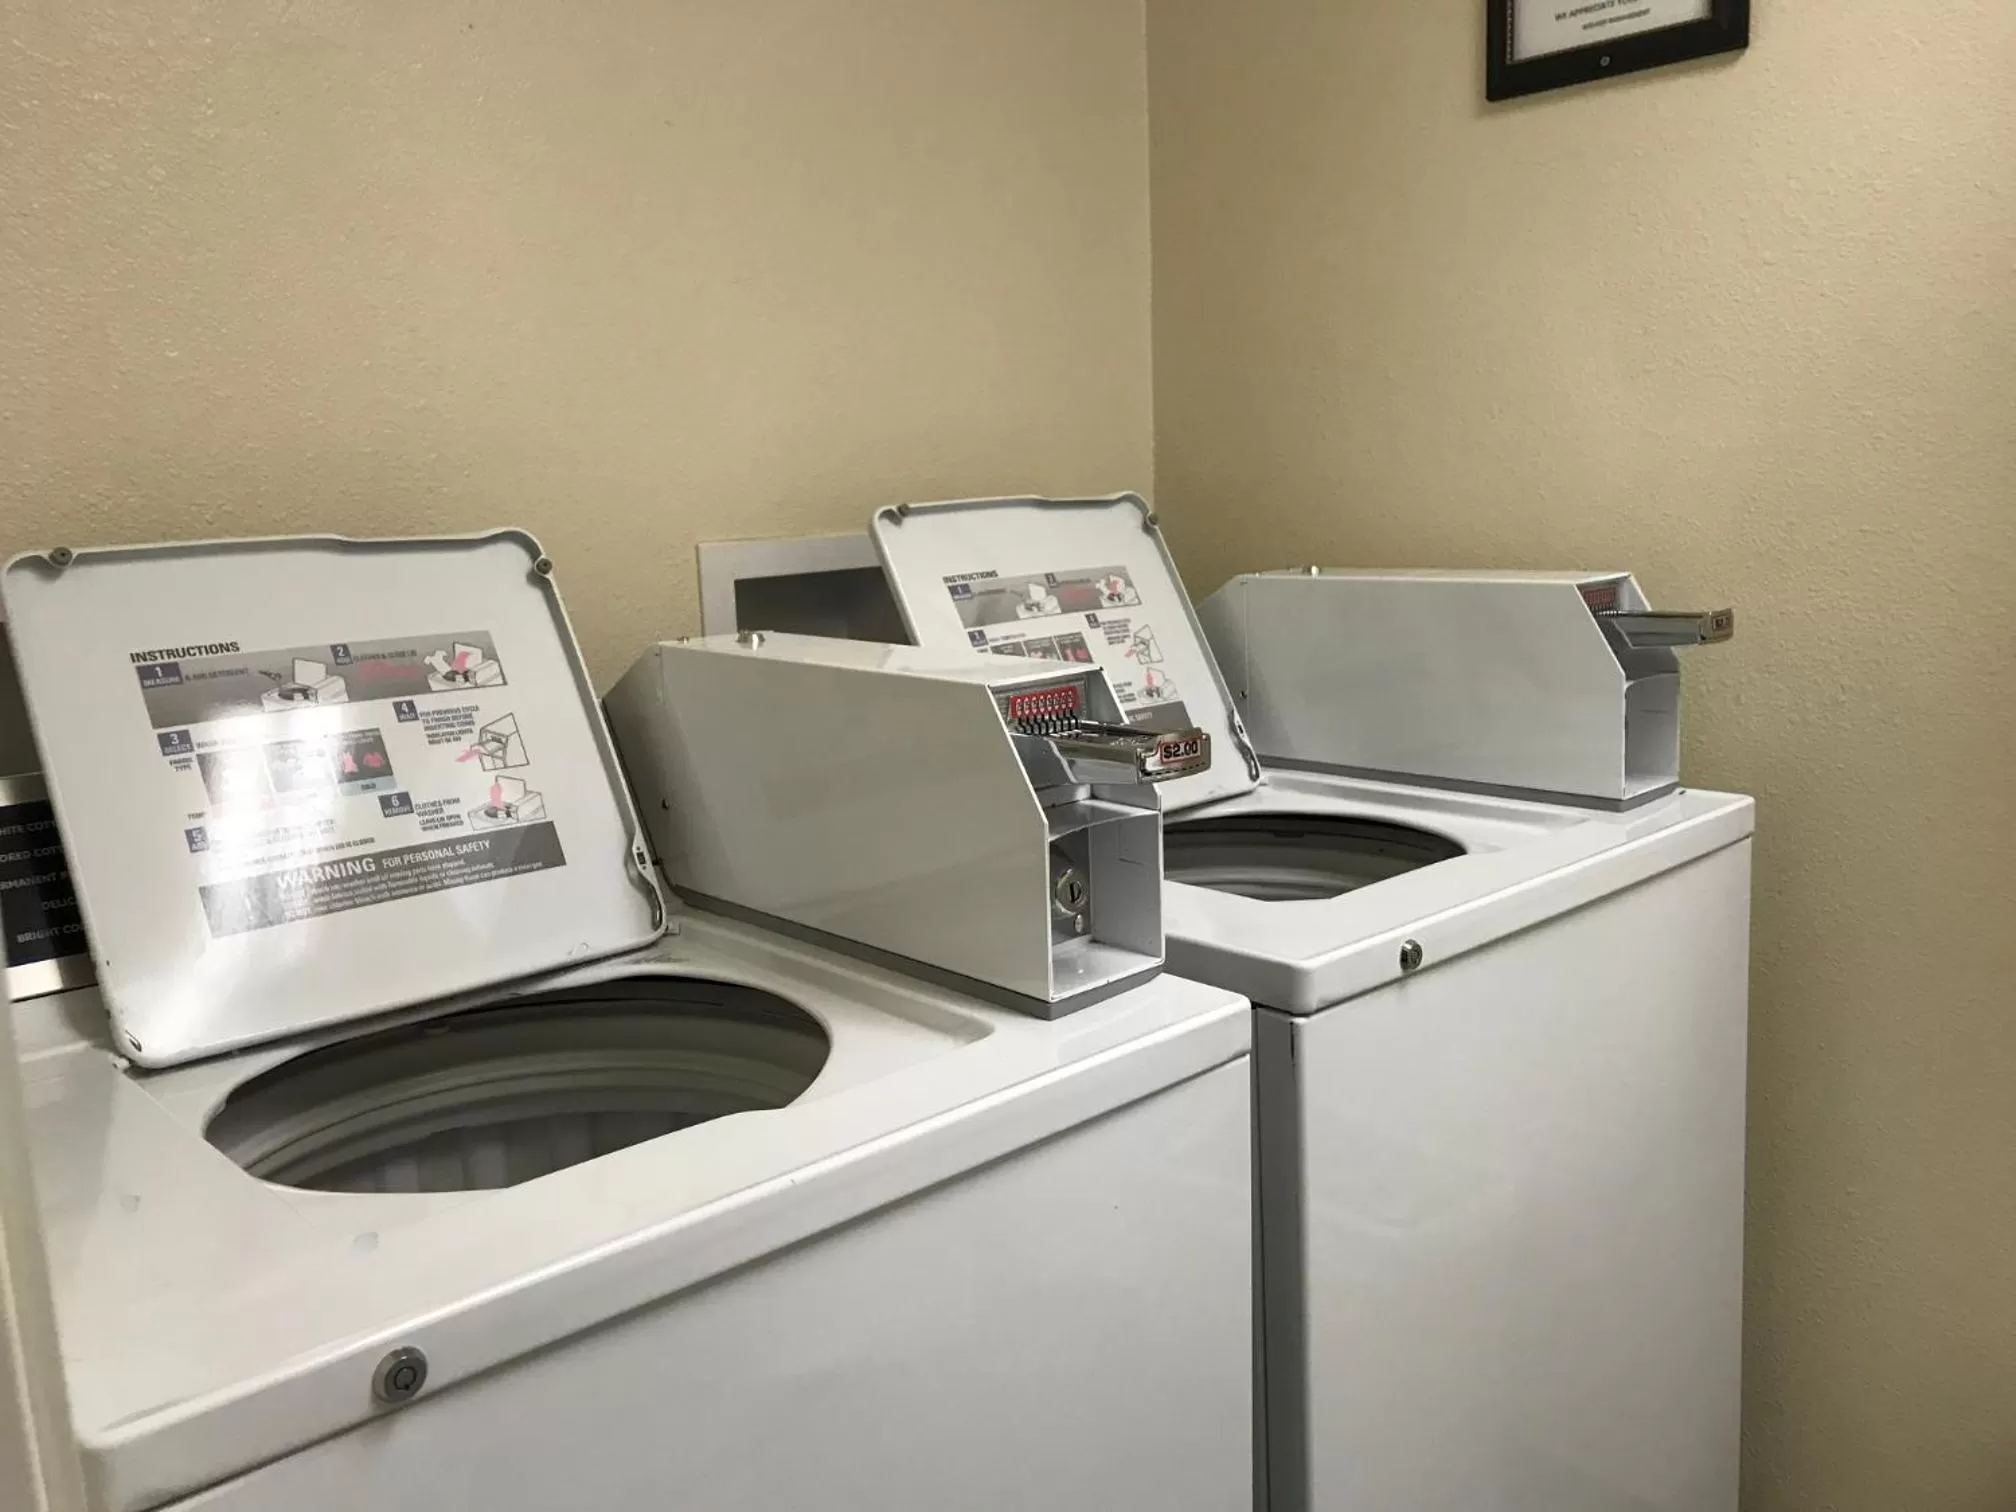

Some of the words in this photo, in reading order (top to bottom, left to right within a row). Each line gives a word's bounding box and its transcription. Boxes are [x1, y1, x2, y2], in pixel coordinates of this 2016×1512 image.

[942, 570, 998, 584] INSTRUCTIONS
[129, 641, 241, 664] INSTRUCTIONS
[337, 646, 345, 657] 2
[155, 667, 162, 678] 1
[401, 702, 408, 714] 4
[169, 733, 180, 745] 3
[391, 795, 400, 808] 6
[277, 857, 375, 889] WARNING
[382, 857, 402, 870] FOR
[403, 846, 454, 865] PERSONAL
[455, 839, 490, 855] SAFETY
[16, 926, 60, 944] BRIGHT
